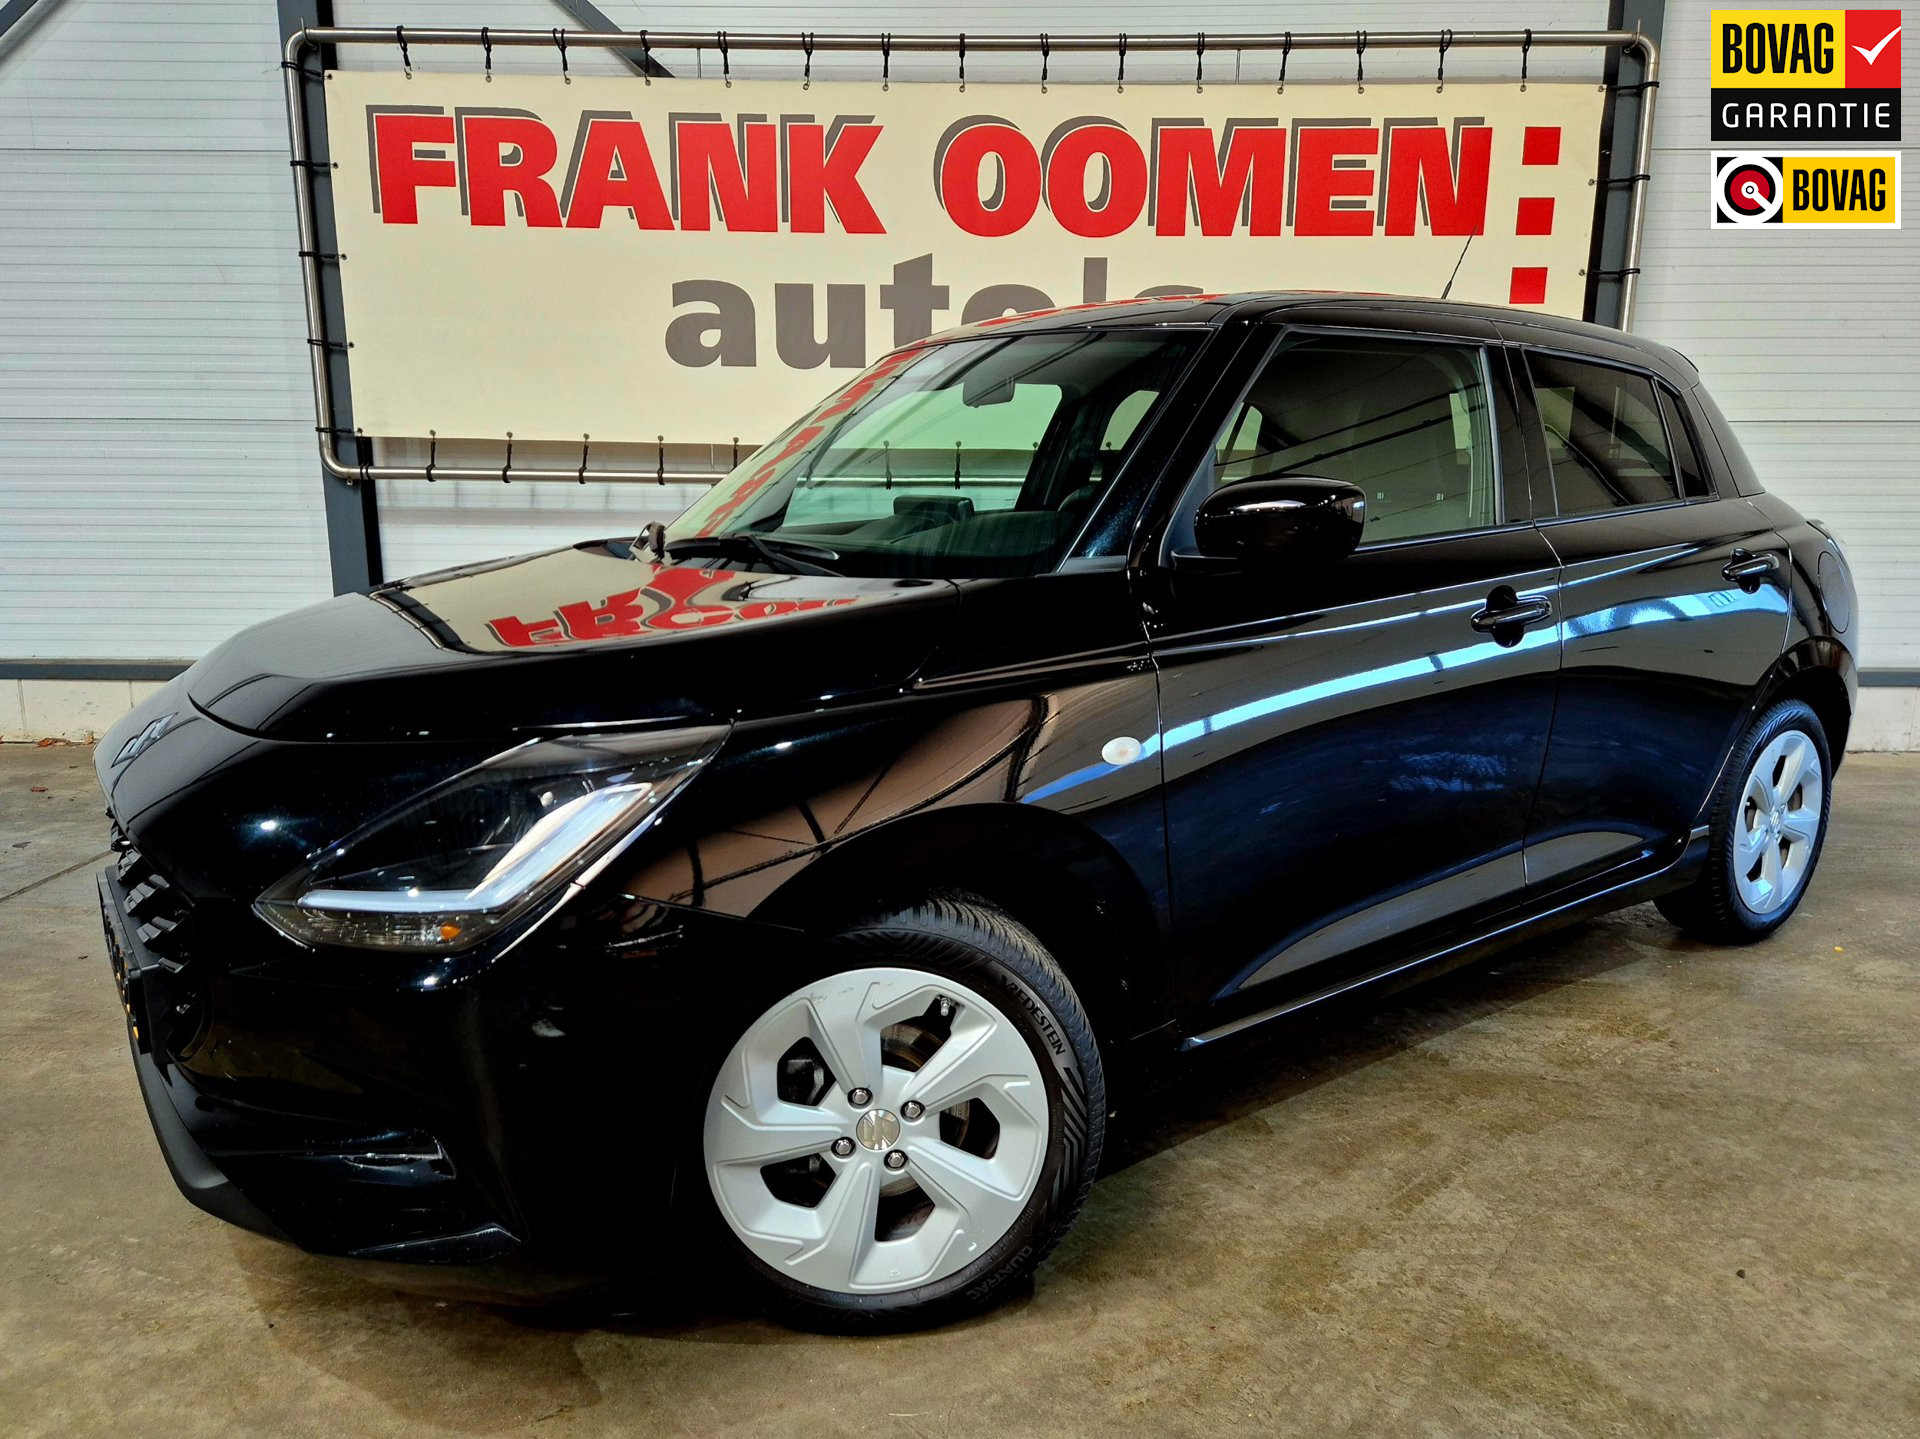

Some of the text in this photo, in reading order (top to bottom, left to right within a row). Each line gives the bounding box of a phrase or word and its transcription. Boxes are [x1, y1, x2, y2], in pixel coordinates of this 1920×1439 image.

[366, 104, 1493, 238] FRANK OOMEN
[665, 252, 1204, 370] aut'
[1001, 974, 1066, 1056] VREDESTEIN
[965, 1244, 1033, 1301] QUATRAC
